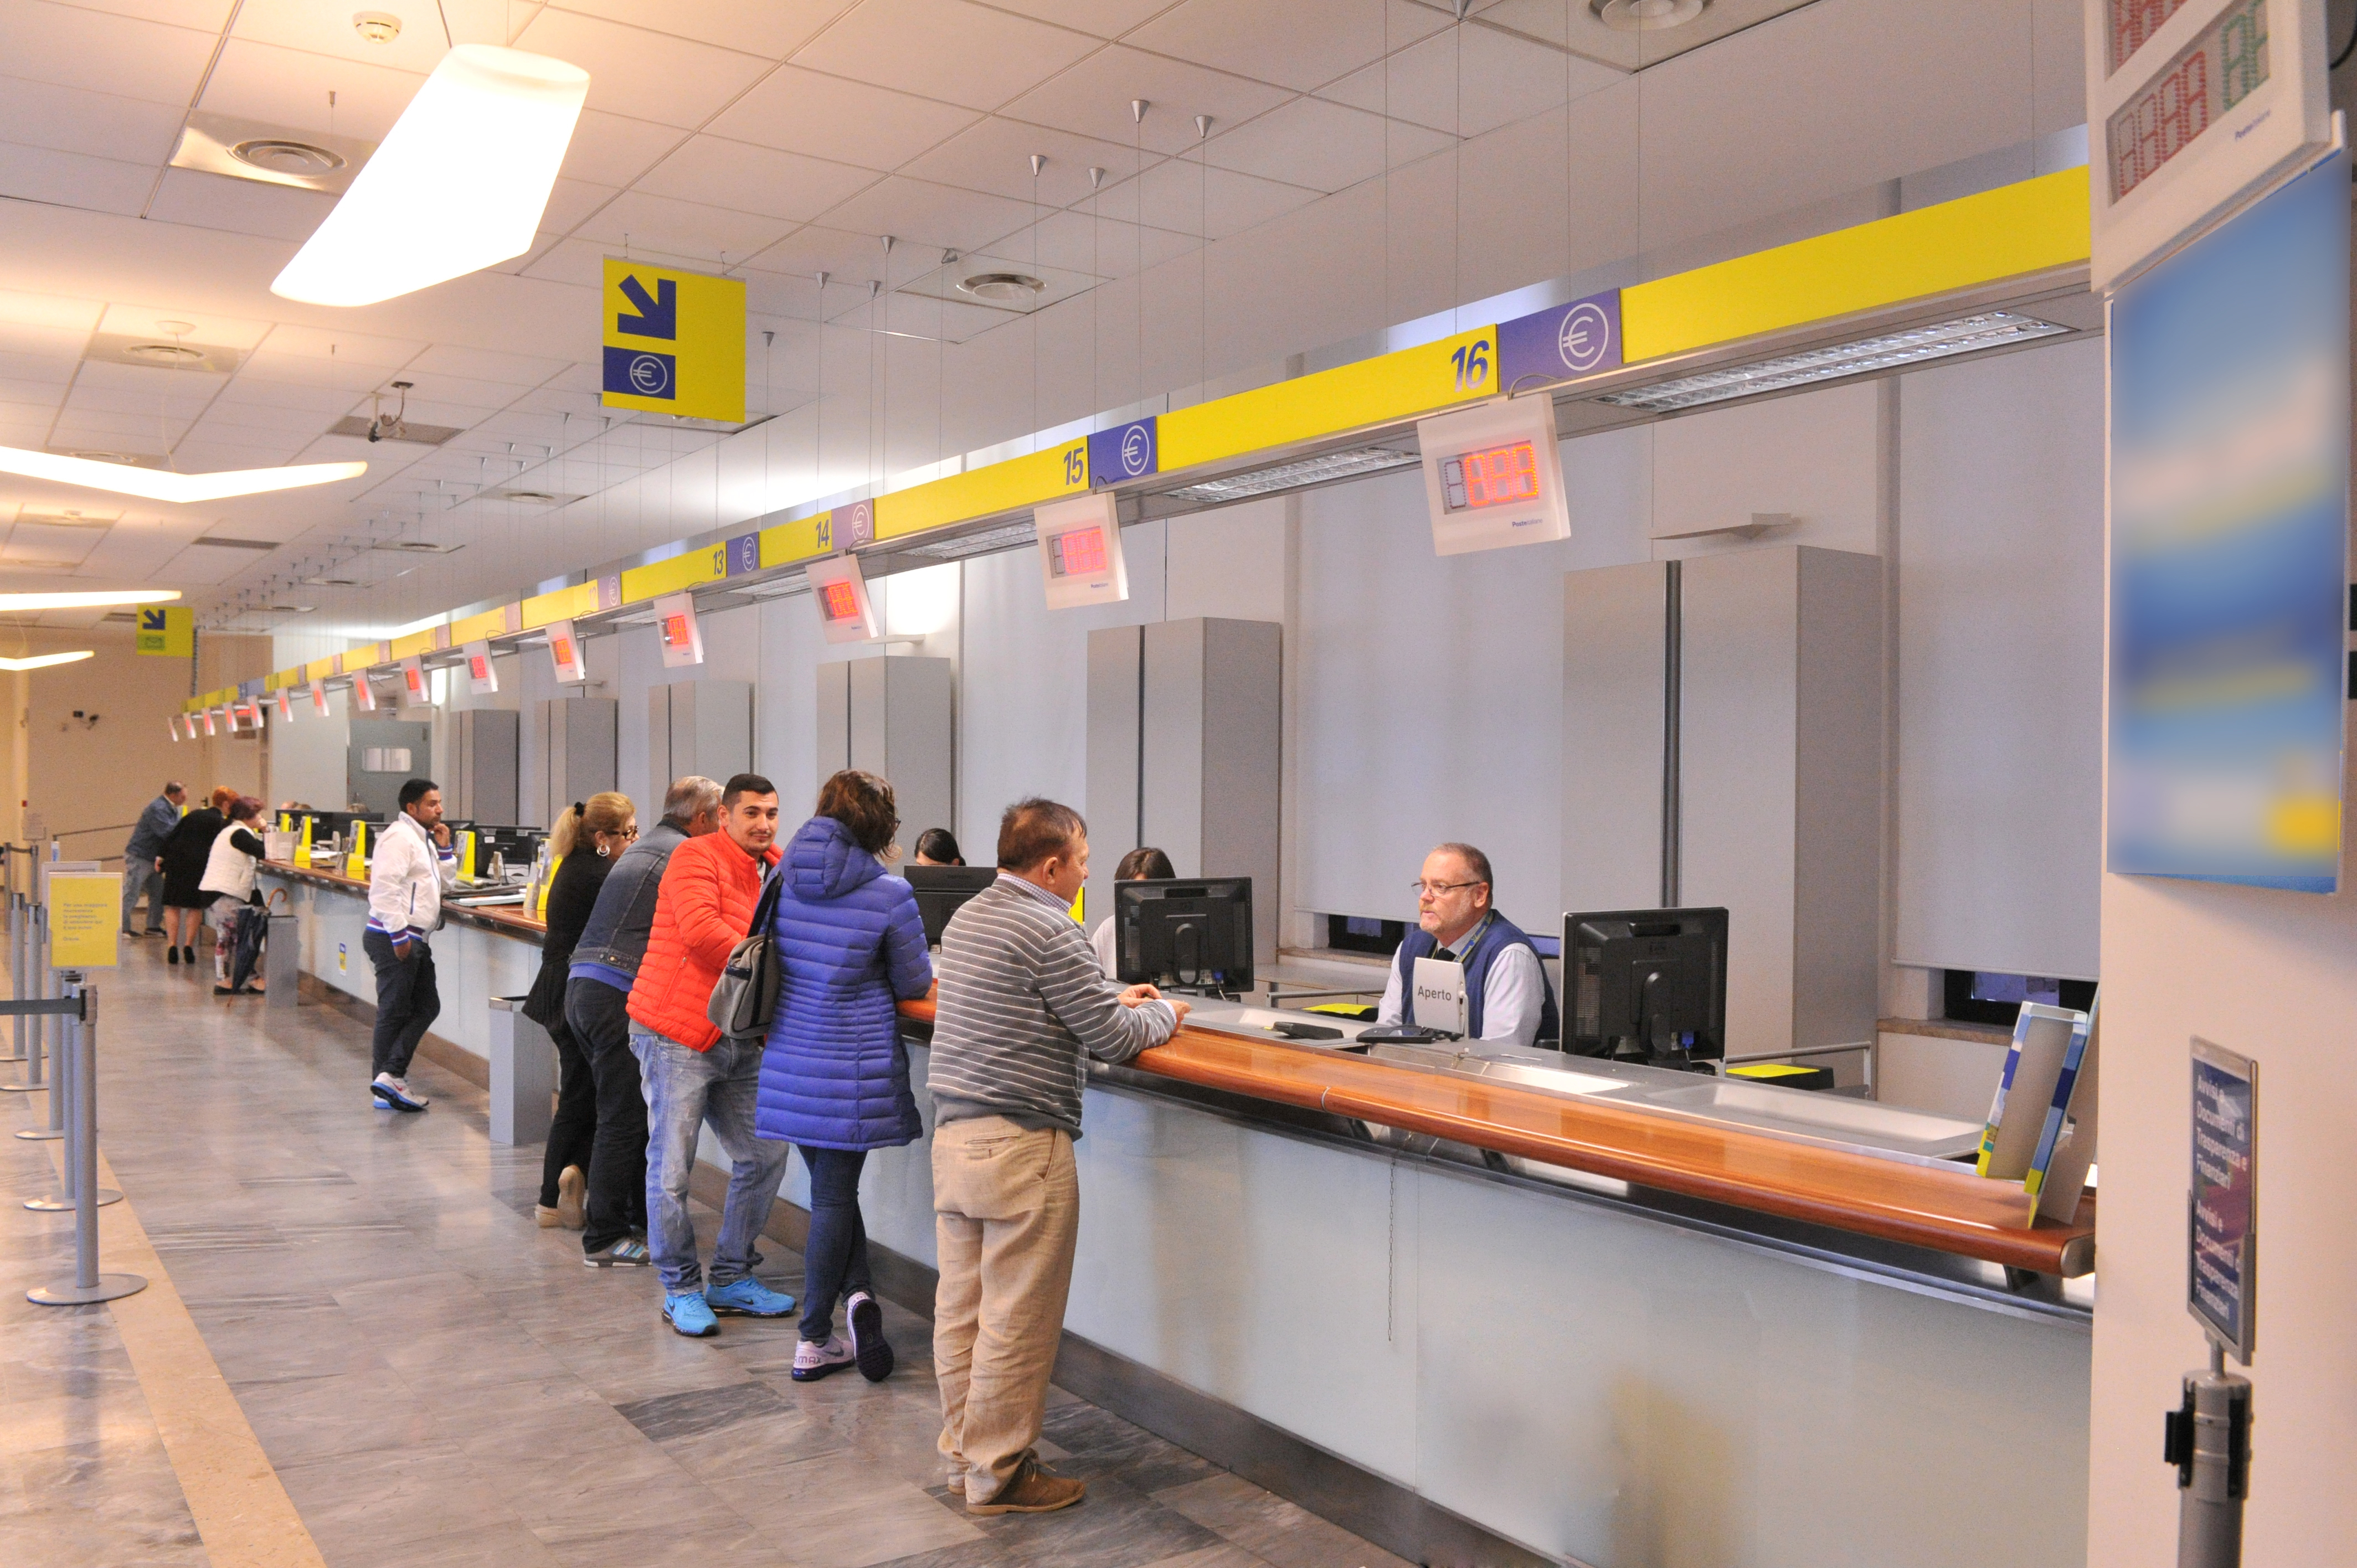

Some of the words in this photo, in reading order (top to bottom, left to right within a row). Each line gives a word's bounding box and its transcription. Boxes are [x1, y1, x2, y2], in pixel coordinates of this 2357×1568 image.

[1450, 340, 1490, 392] 16
[1063, 447, 1084, 486] 15
[816, 519, 830, 548] 14
[713, 548, 724, 575] 13
[1418, 986, 1452, 1000] Aperto
